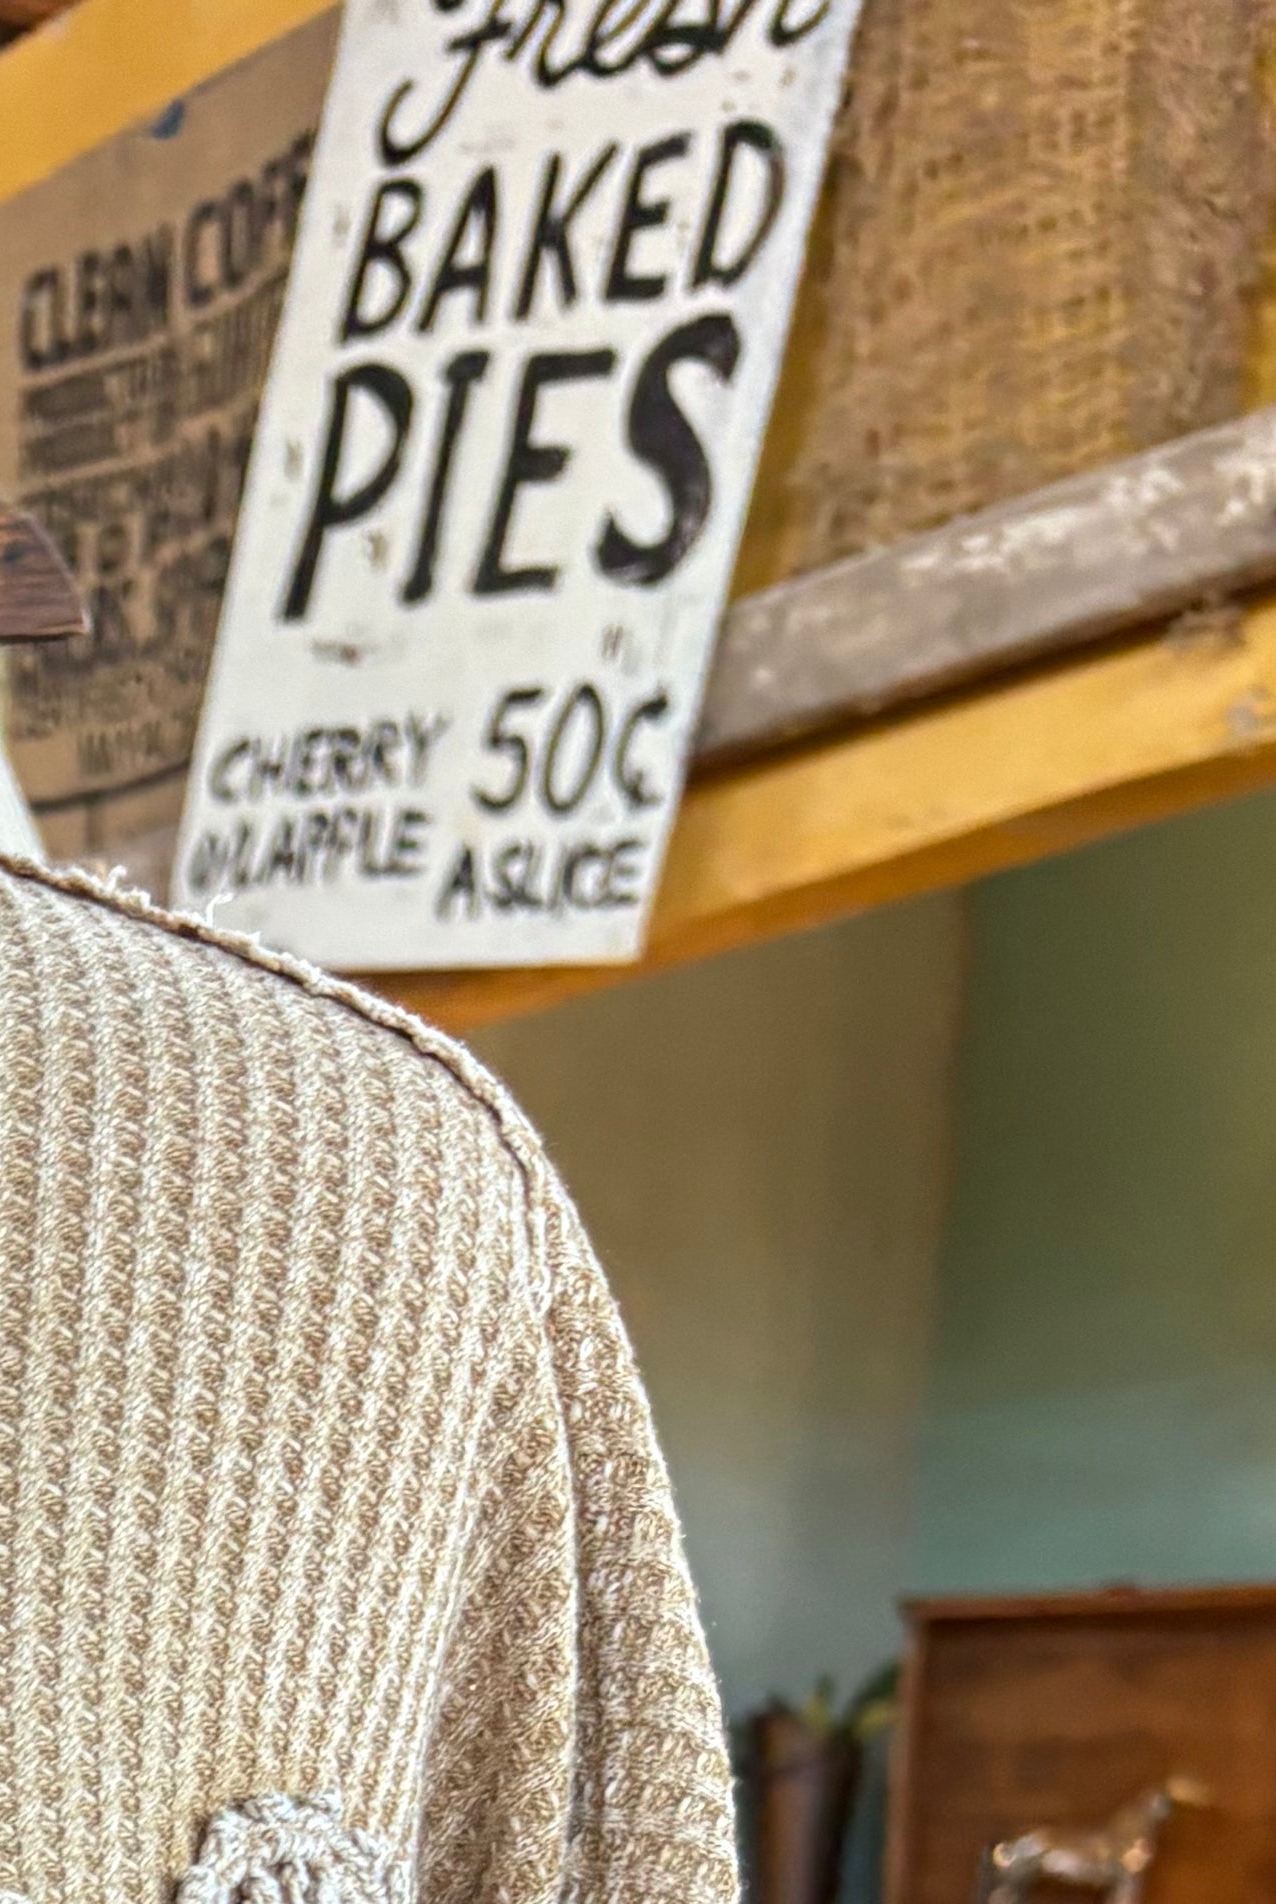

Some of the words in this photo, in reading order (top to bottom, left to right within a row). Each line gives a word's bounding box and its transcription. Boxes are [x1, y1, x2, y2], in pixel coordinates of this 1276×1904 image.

[340, 119, 786, 348] BAKED
[279, 312, 742, 621] PIES
[208, 708, 452, 802] CHERRY
[253, 806, 431, 888] APPLE
[435, 844, 483, 925] A
[483, 836, 648, 919] SLICE
